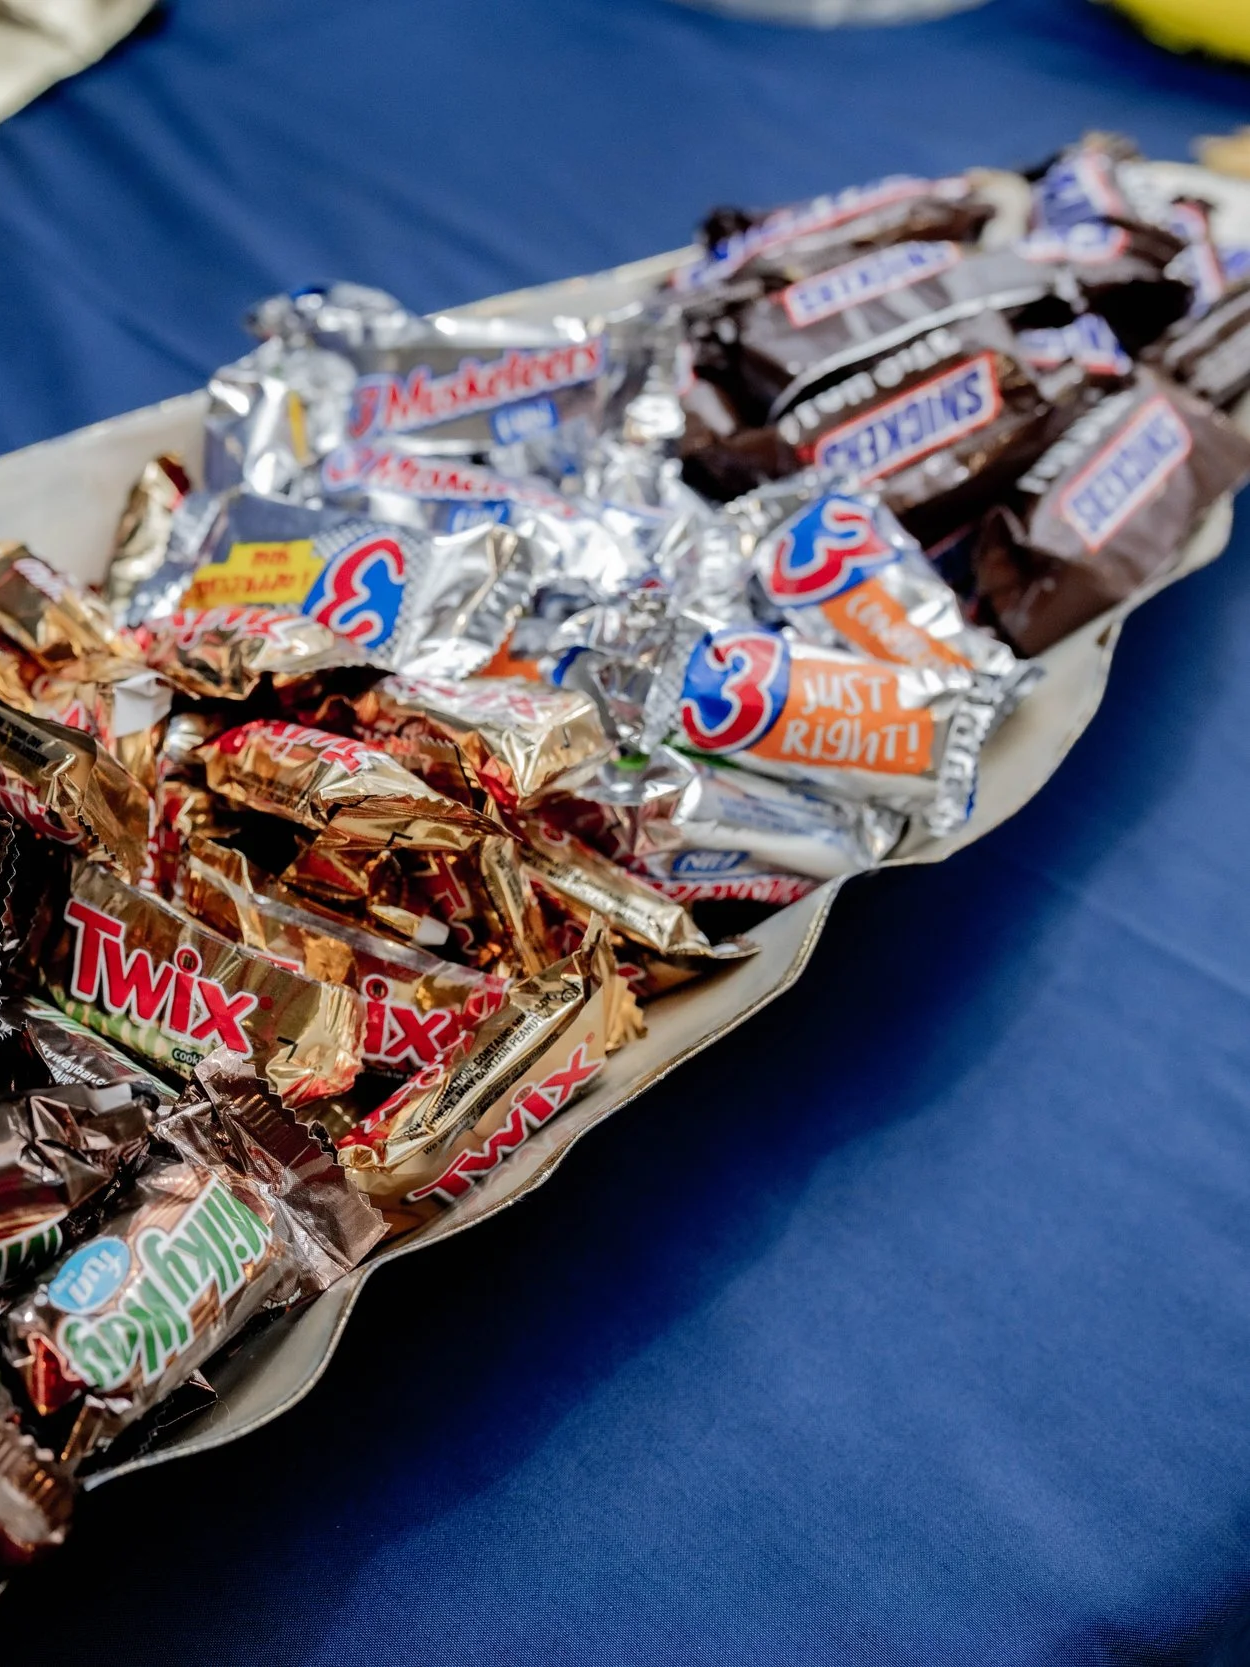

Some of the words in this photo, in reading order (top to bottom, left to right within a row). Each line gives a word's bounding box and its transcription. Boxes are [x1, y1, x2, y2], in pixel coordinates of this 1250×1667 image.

[383, 341, 601, 421] Musketeers
[822, 371, 980, 469] SNICKERS
[682, 633, 778, 754] 3
[64, 896, 258, 1058] Twix
[457, 1078, 478, 1099] MAY
[474, 1043, 513, 1081] CONTAIN
[473, 1025, 516, 1067] CONTAINS
[406, 1041, 605, 1203] Twix
[68, 1249, 123, 1304] fun
[139, 1176, 271, 1312] Milky
